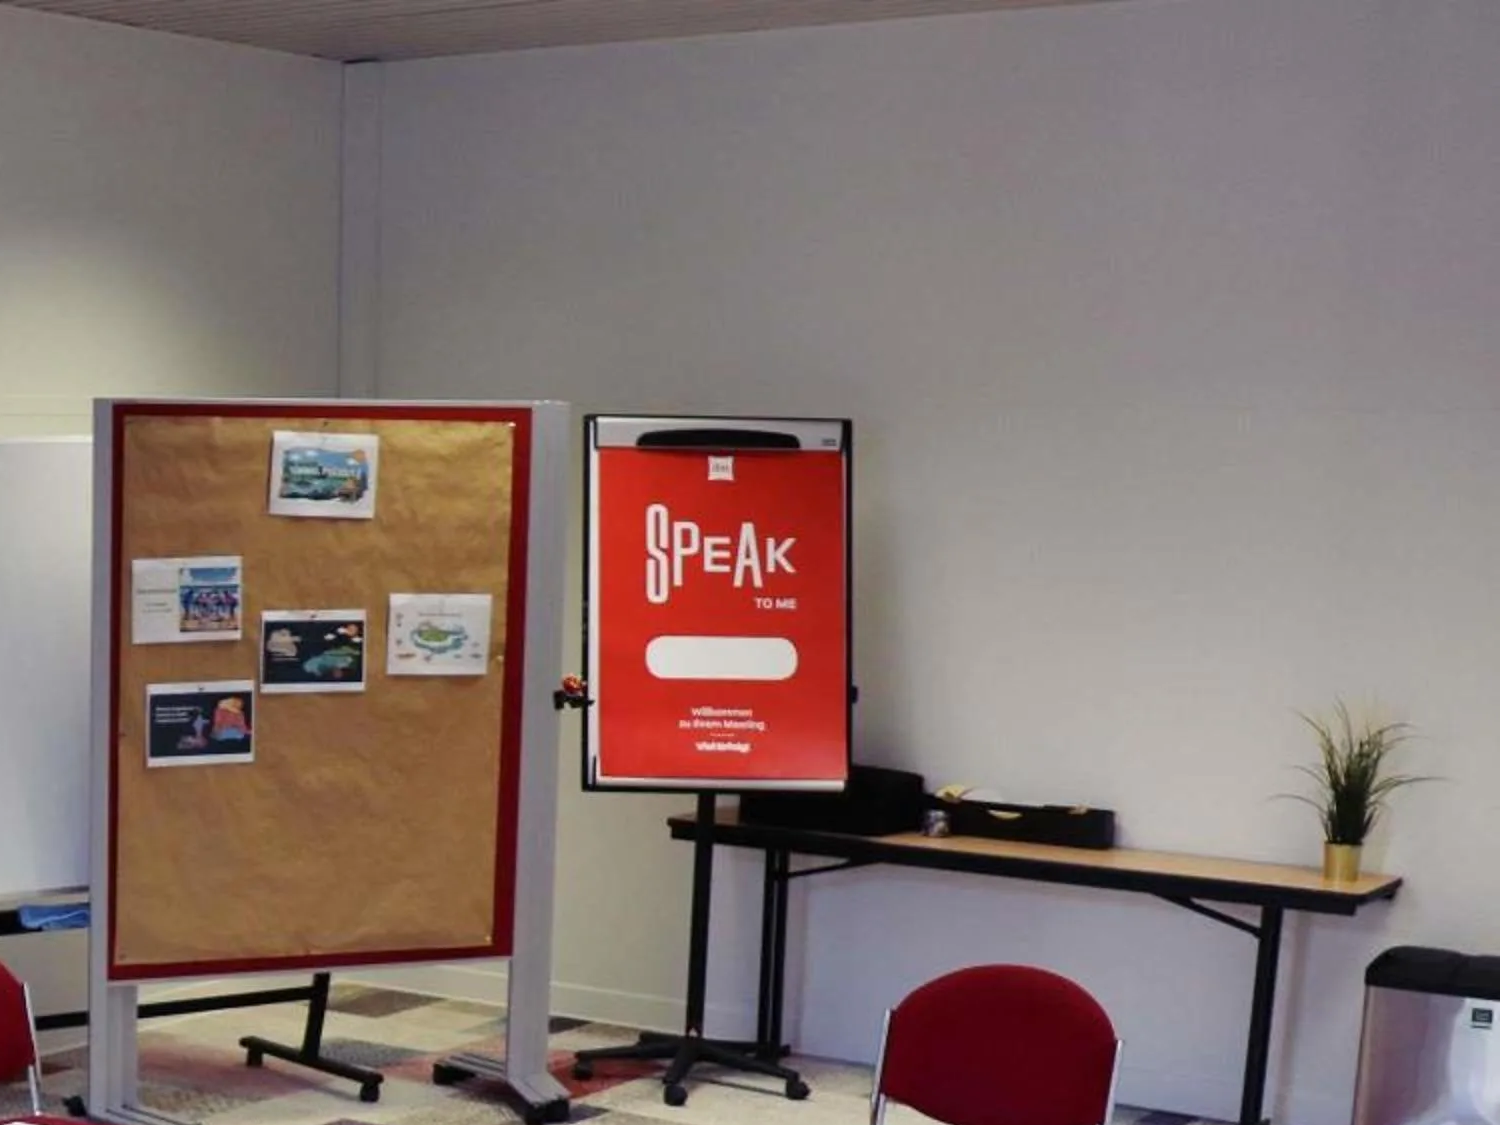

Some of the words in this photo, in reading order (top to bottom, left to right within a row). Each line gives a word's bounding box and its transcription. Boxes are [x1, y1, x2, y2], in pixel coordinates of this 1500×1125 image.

[646, 503, 797, 604] SPEAK
[755, 597, 773, 609] TO
[776, 598, 797, 610] ME
